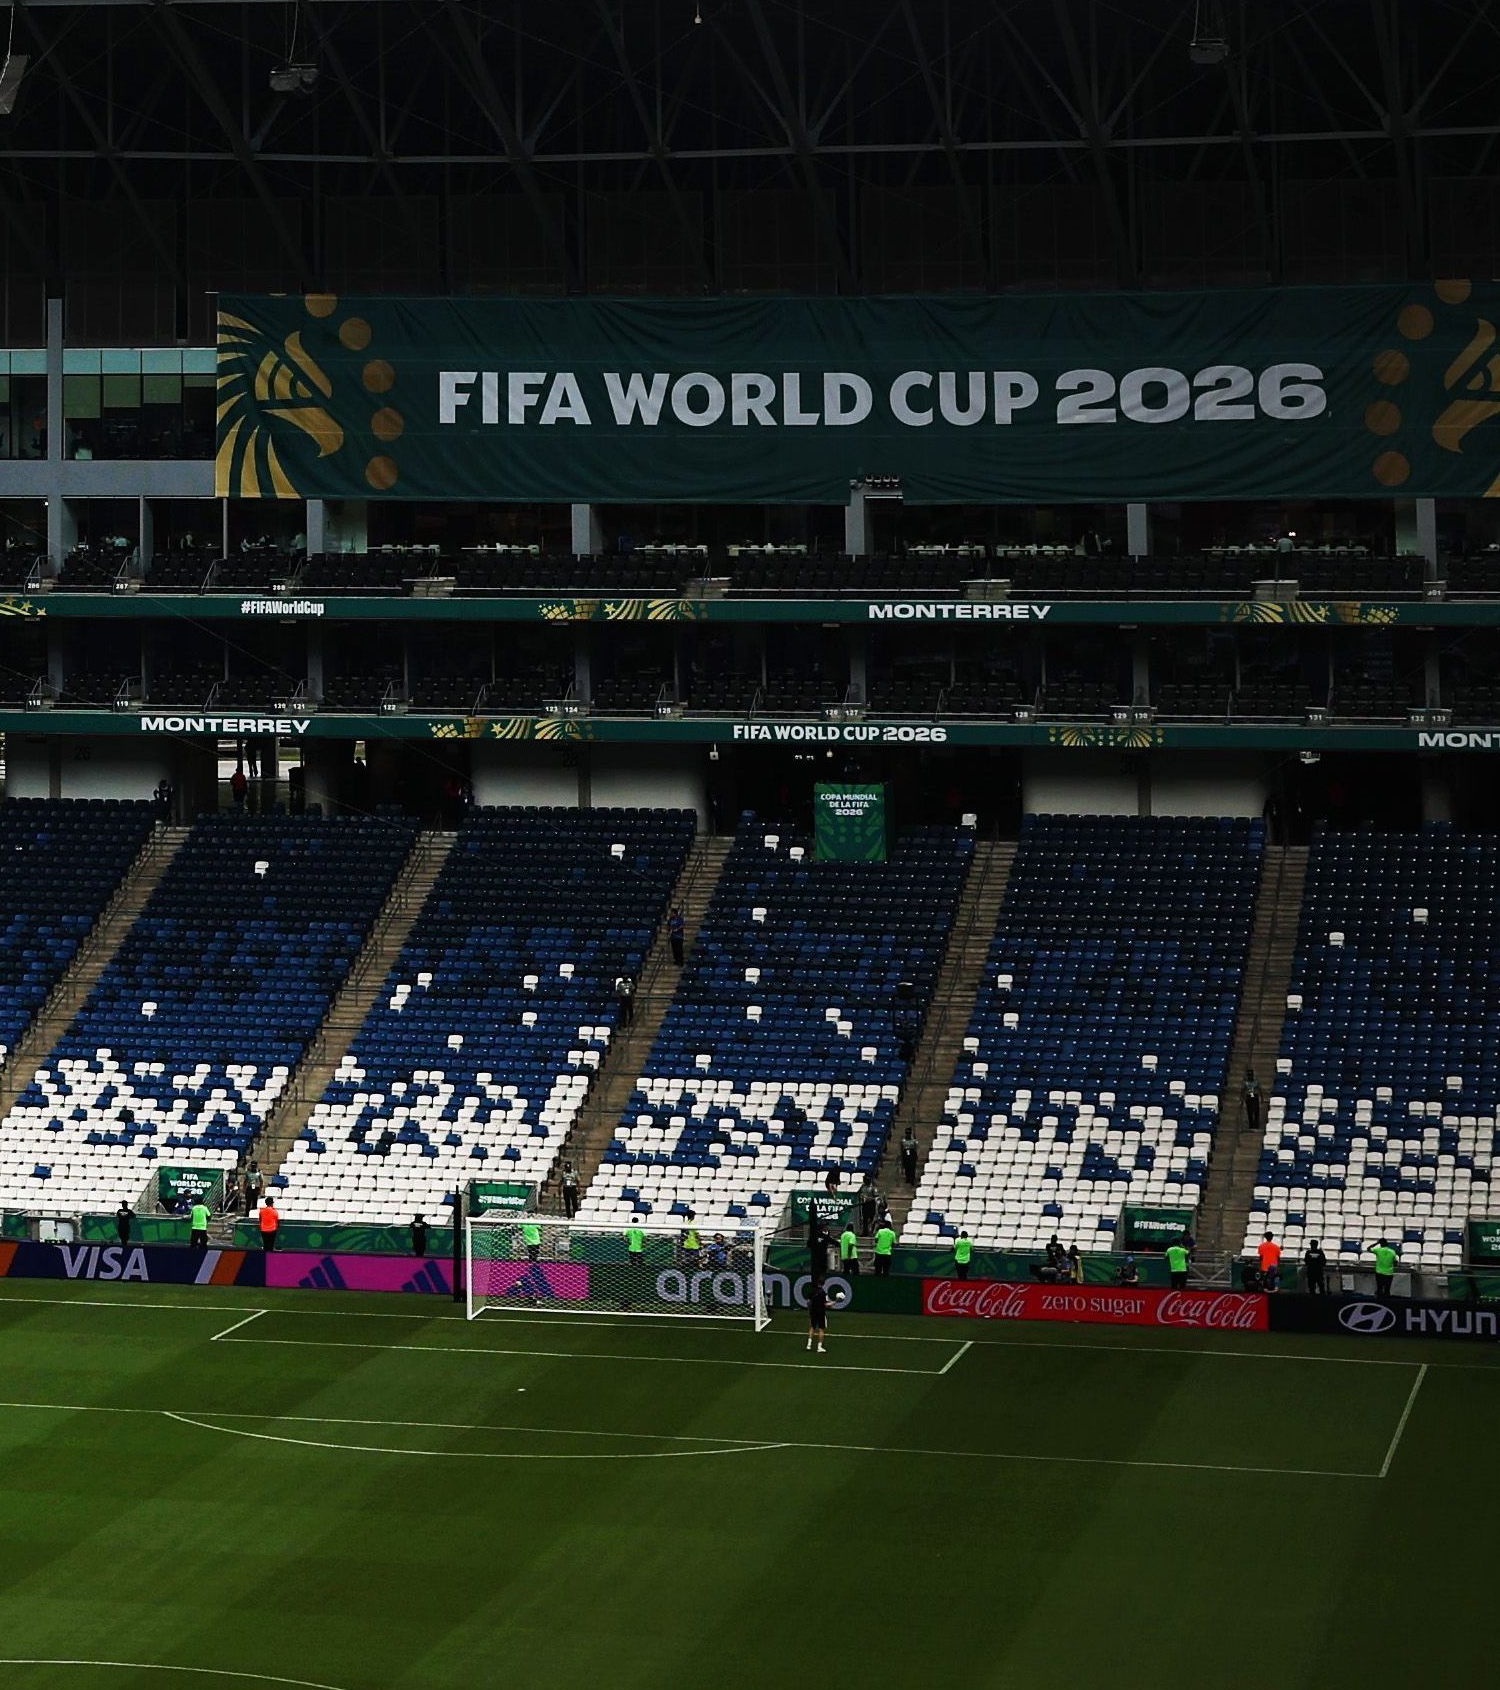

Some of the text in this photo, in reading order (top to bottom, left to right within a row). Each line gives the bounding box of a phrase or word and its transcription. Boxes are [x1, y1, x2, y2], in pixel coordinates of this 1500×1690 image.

[440, 364, 1326, 426] FIFA WORLD CUP 2026
[241, 600, 325, 616] #FIFAWorldCup
[868, 603, 1051, 619] MONTERREY
[142, 717, 310, 733] MONTERREY
[734, 725, 946, 741] FIFA WORLD CUP 2026
[62, 1246, 149, 1281] VISA
[656, 1268, 853, 1310] aramco
[1042, 1294, 1087, 1311] zero
[1091, 1296, 1146, 1320] sugar
